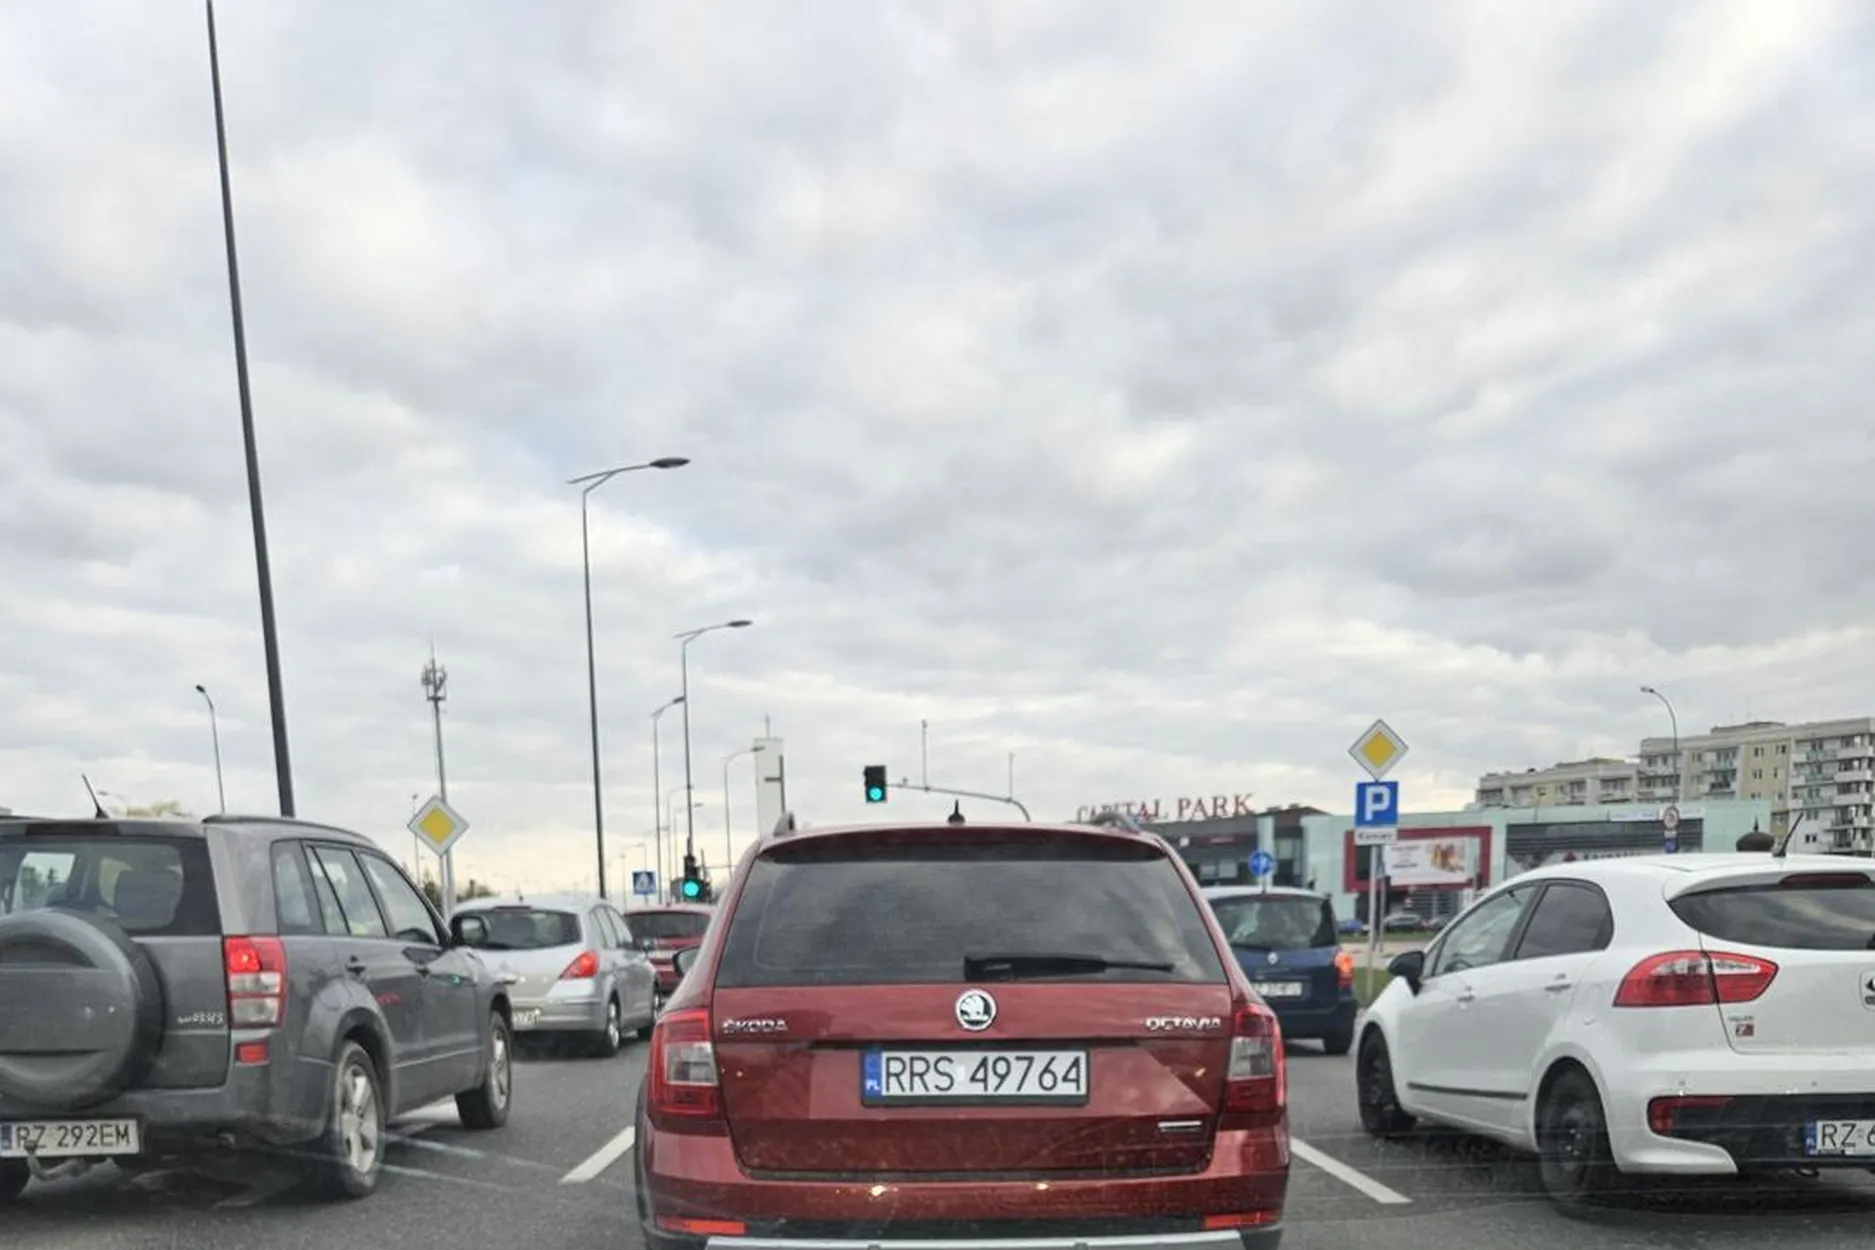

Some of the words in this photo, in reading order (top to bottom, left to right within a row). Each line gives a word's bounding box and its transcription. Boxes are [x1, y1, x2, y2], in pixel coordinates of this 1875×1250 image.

[1177, 793, 1254, 820] PARK
[1364, 785, 1390, 821] P
[885, 1056, 954, 1092] RRS
[969, 1055, 1081, 1092] 49764
[16, 1124, 46, 1149] RZ
[57, 1123, 131, 1147] 292EM
[1822, 1123, 1857, 1148] RZ
